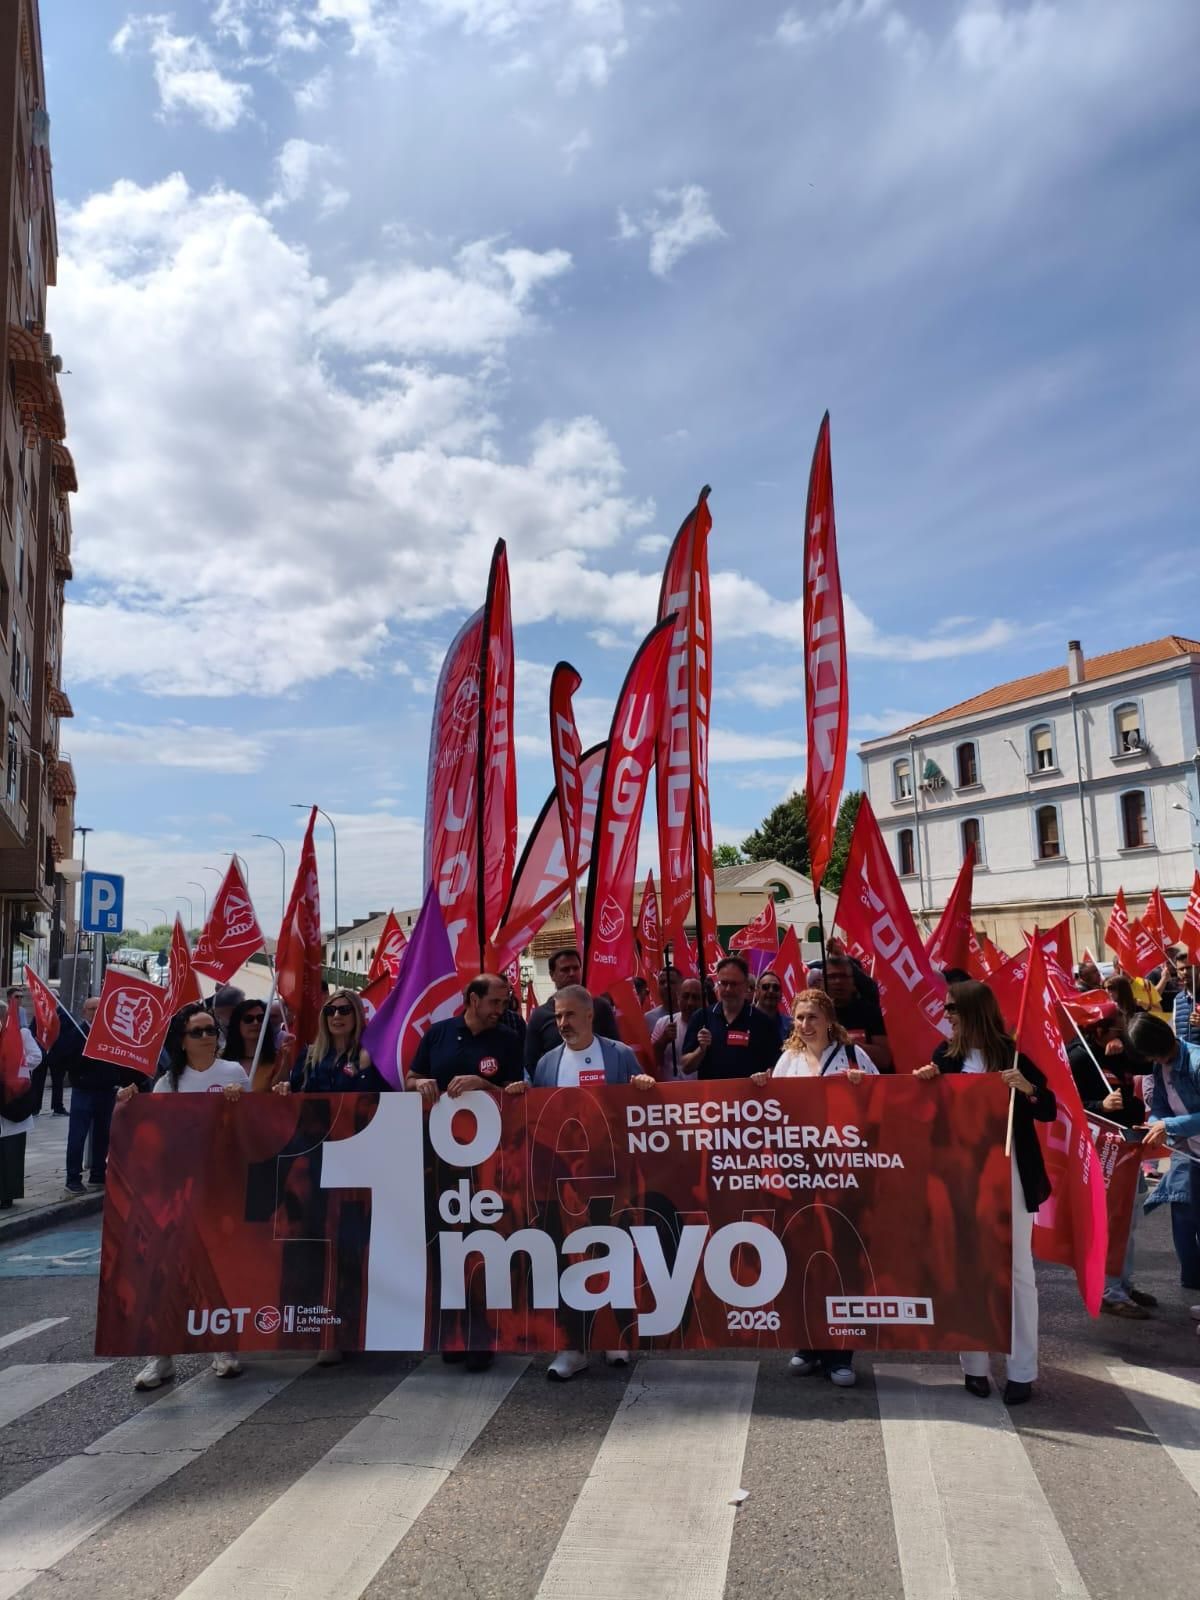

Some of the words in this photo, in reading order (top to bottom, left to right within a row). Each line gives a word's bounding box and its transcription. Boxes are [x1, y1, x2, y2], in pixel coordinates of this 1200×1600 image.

[608, 693, 650, 888] UGT
[91, 879, 117, 926] P
[111, 991, 139, 1039] UGT
[626, 1099, 790, 1128] DERECHOS,
[627, 1130, 671, 1154] NO
[676, 1125, 869, 1151] TRINCHERAS.
[711, 1153, 810, 1171] SALARIOS,
[814, 1152, 905, 1170] VIVIENDA
[711, 1176, 724, 1191] Y
[729, 1173, 860, 1190] DEMOCRACIA
[438, 1178, 504, 1225] de
[438, 1220, 788, 1337] mayo
[186, 1306, 252, 1336] UGT
[296, 1315, 308, 1325] La
[310, 1315, 342, 1325] Mancha
[297, 1305, 332, 1315] Castilla-
[727, 1310, 781, 1331] 2026
[831, 1302, 899, 1318] CCOO
[828, 1326, 867, 1337] Cuenca
